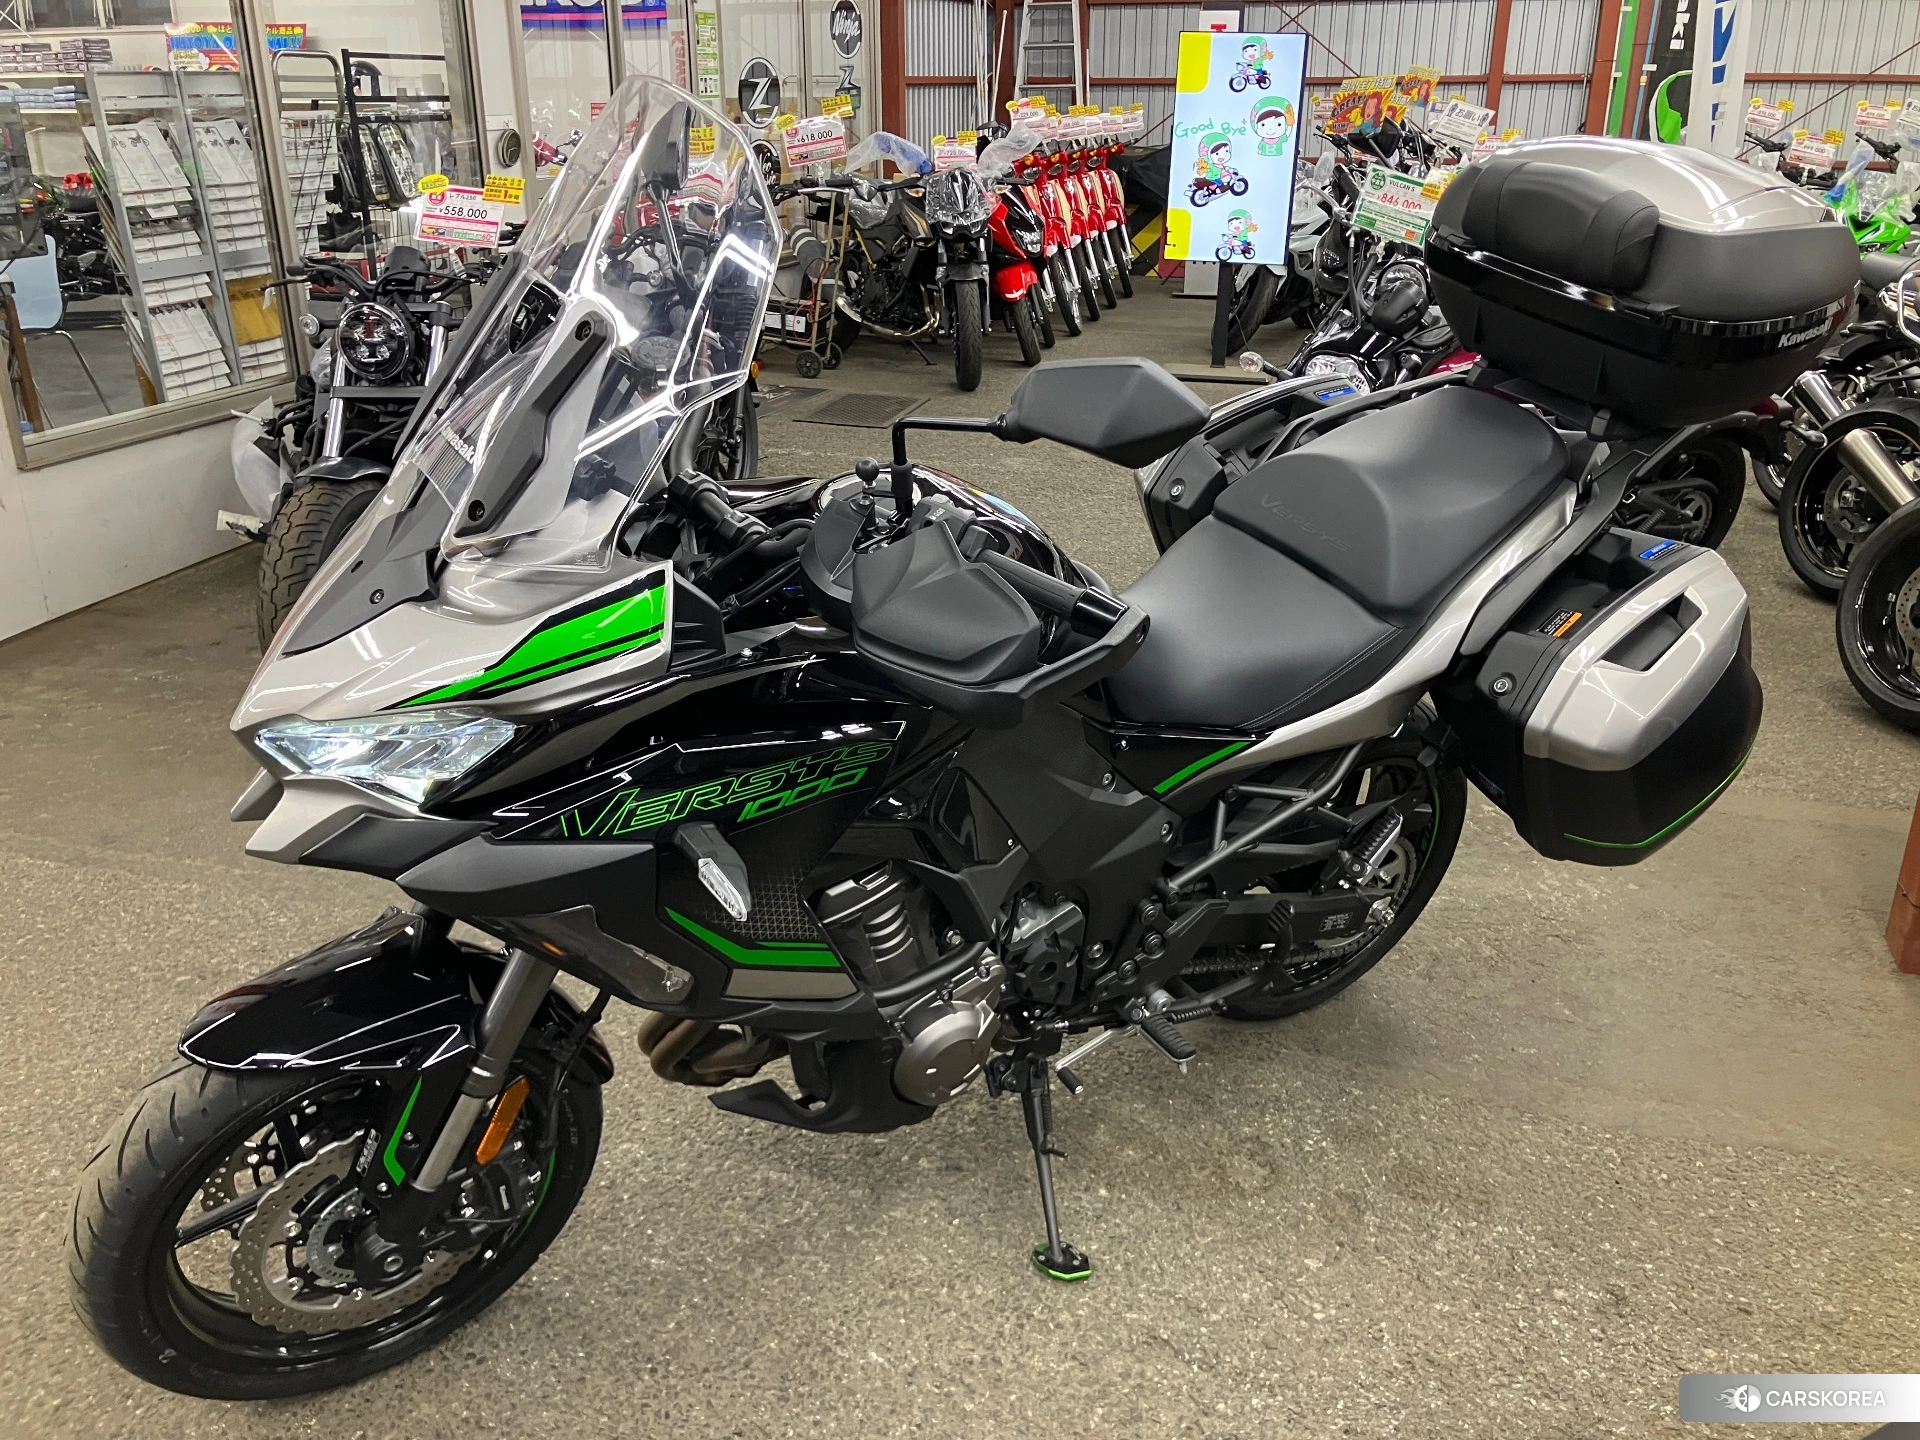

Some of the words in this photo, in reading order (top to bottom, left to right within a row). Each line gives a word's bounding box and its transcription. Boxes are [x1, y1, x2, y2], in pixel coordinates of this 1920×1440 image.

[832, 9, 860, 43] Ninja
[748, 77, 773, 110] Z
[1174, 117, 1215, 138] Good
[1221, 122, 1247, 136] Bye
[1389, 180, 1411, 192] VULCAN
[439, 205, 488, 220] ¥558,000
[559, 741, 894, 837] VERSYS
[736, 766, 868, 823] 1000
